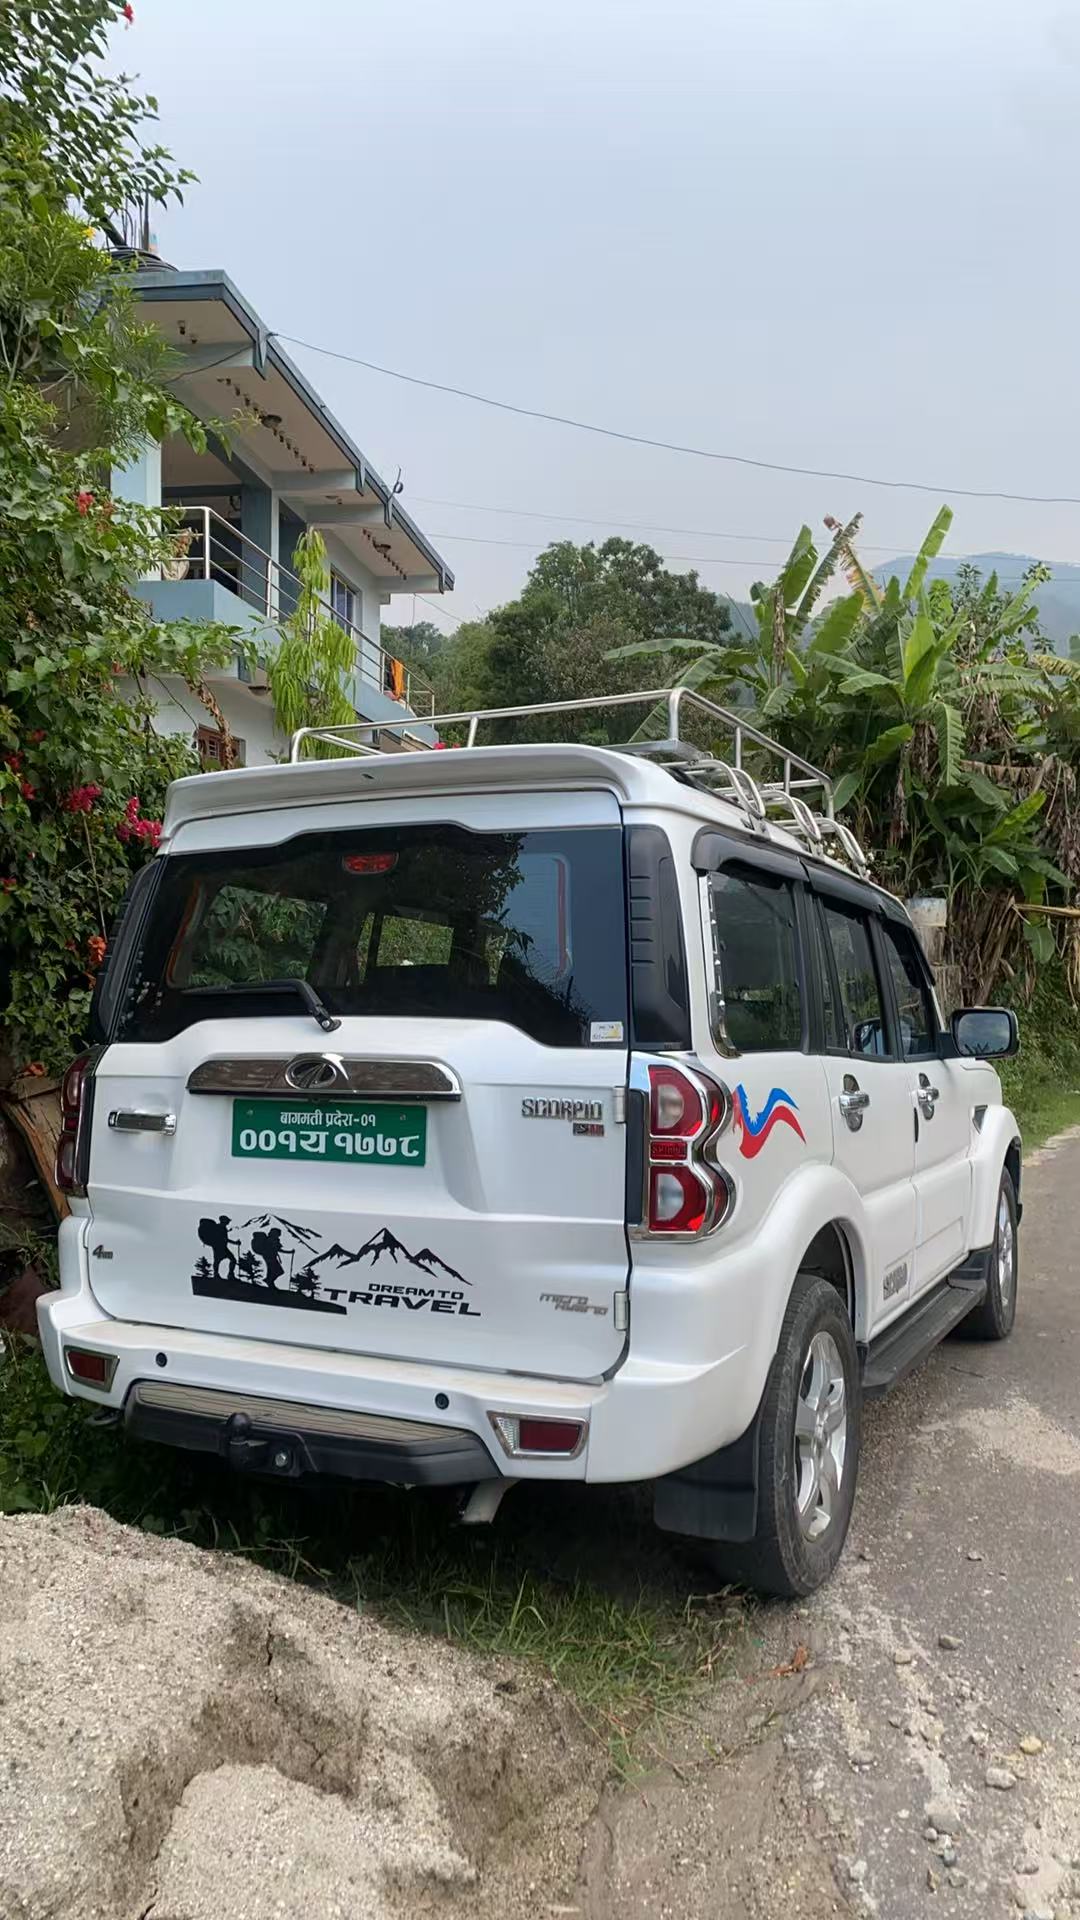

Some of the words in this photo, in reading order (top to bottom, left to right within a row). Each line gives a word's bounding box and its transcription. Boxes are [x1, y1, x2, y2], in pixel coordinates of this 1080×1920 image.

[280, 1109, 323, 1125] बागमती
[521, 1098, 603, 1122] SCORPIO
[334, 1132, 420, 1158] १७७८
[323, 1288, 481, 1317] TRAVEL
[368, 1283, 435, 1298] DREAM
[438, 1290, 464, 1300] TO
